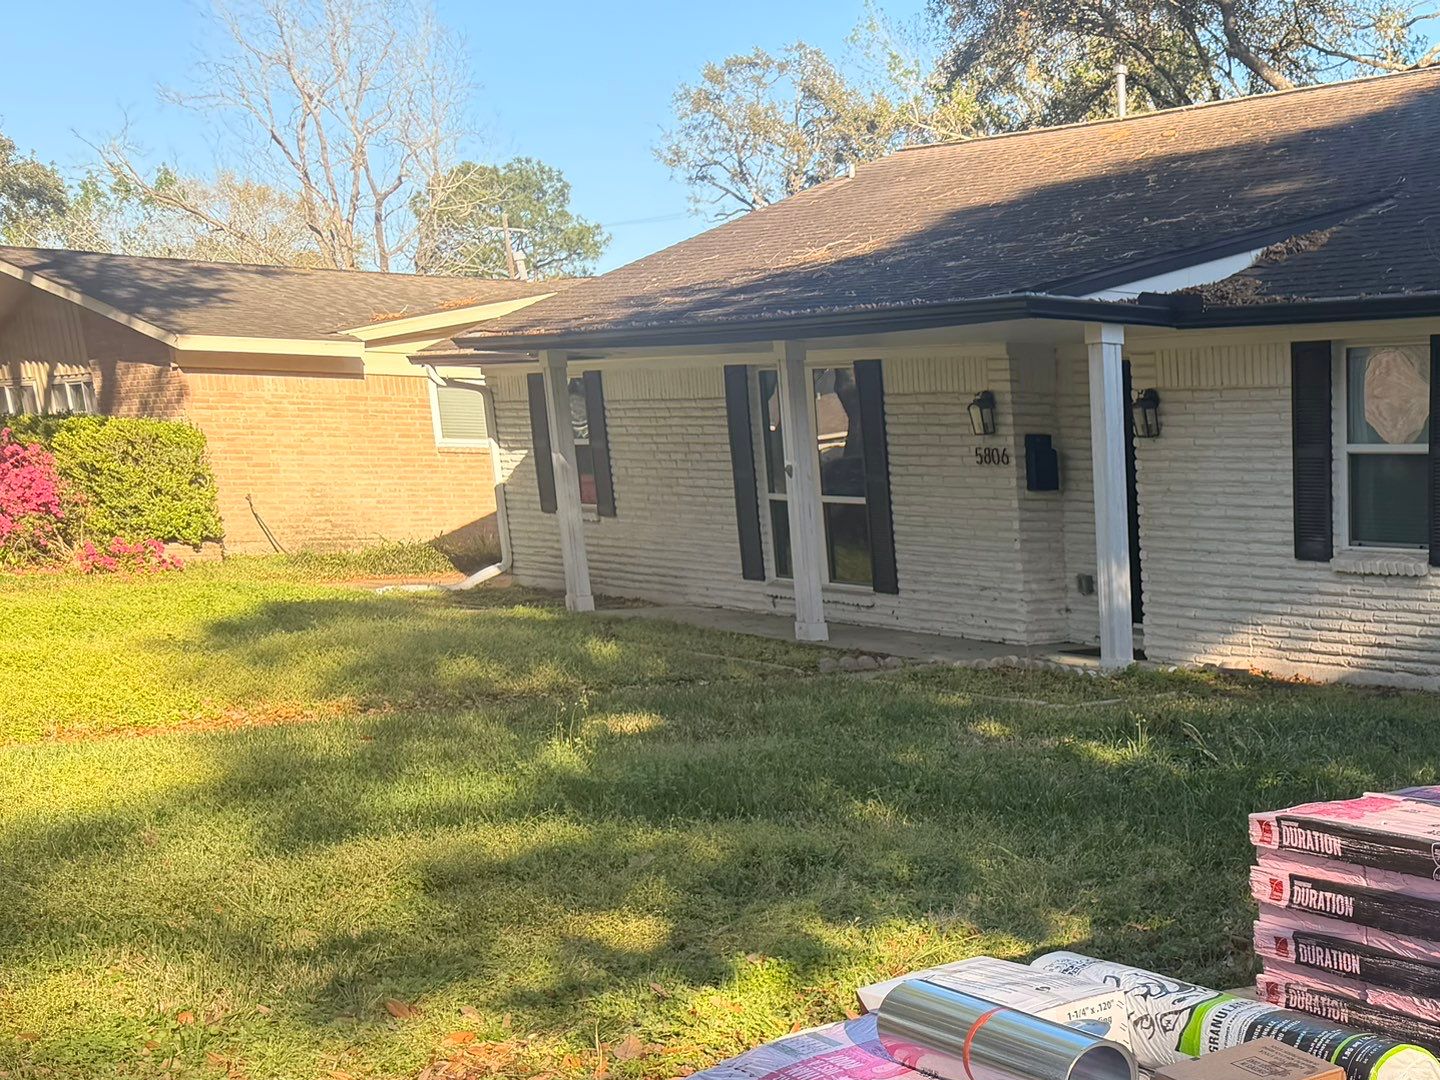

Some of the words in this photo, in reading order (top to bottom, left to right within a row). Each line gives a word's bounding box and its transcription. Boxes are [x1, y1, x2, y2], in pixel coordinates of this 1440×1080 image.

[974, 447, 1010, 466] 5806
[1281, 824, 1342, 857] DURATION
[1293, 887, 1355, 918] DURATION
[1299, 943, 1361, 976] DURATION
